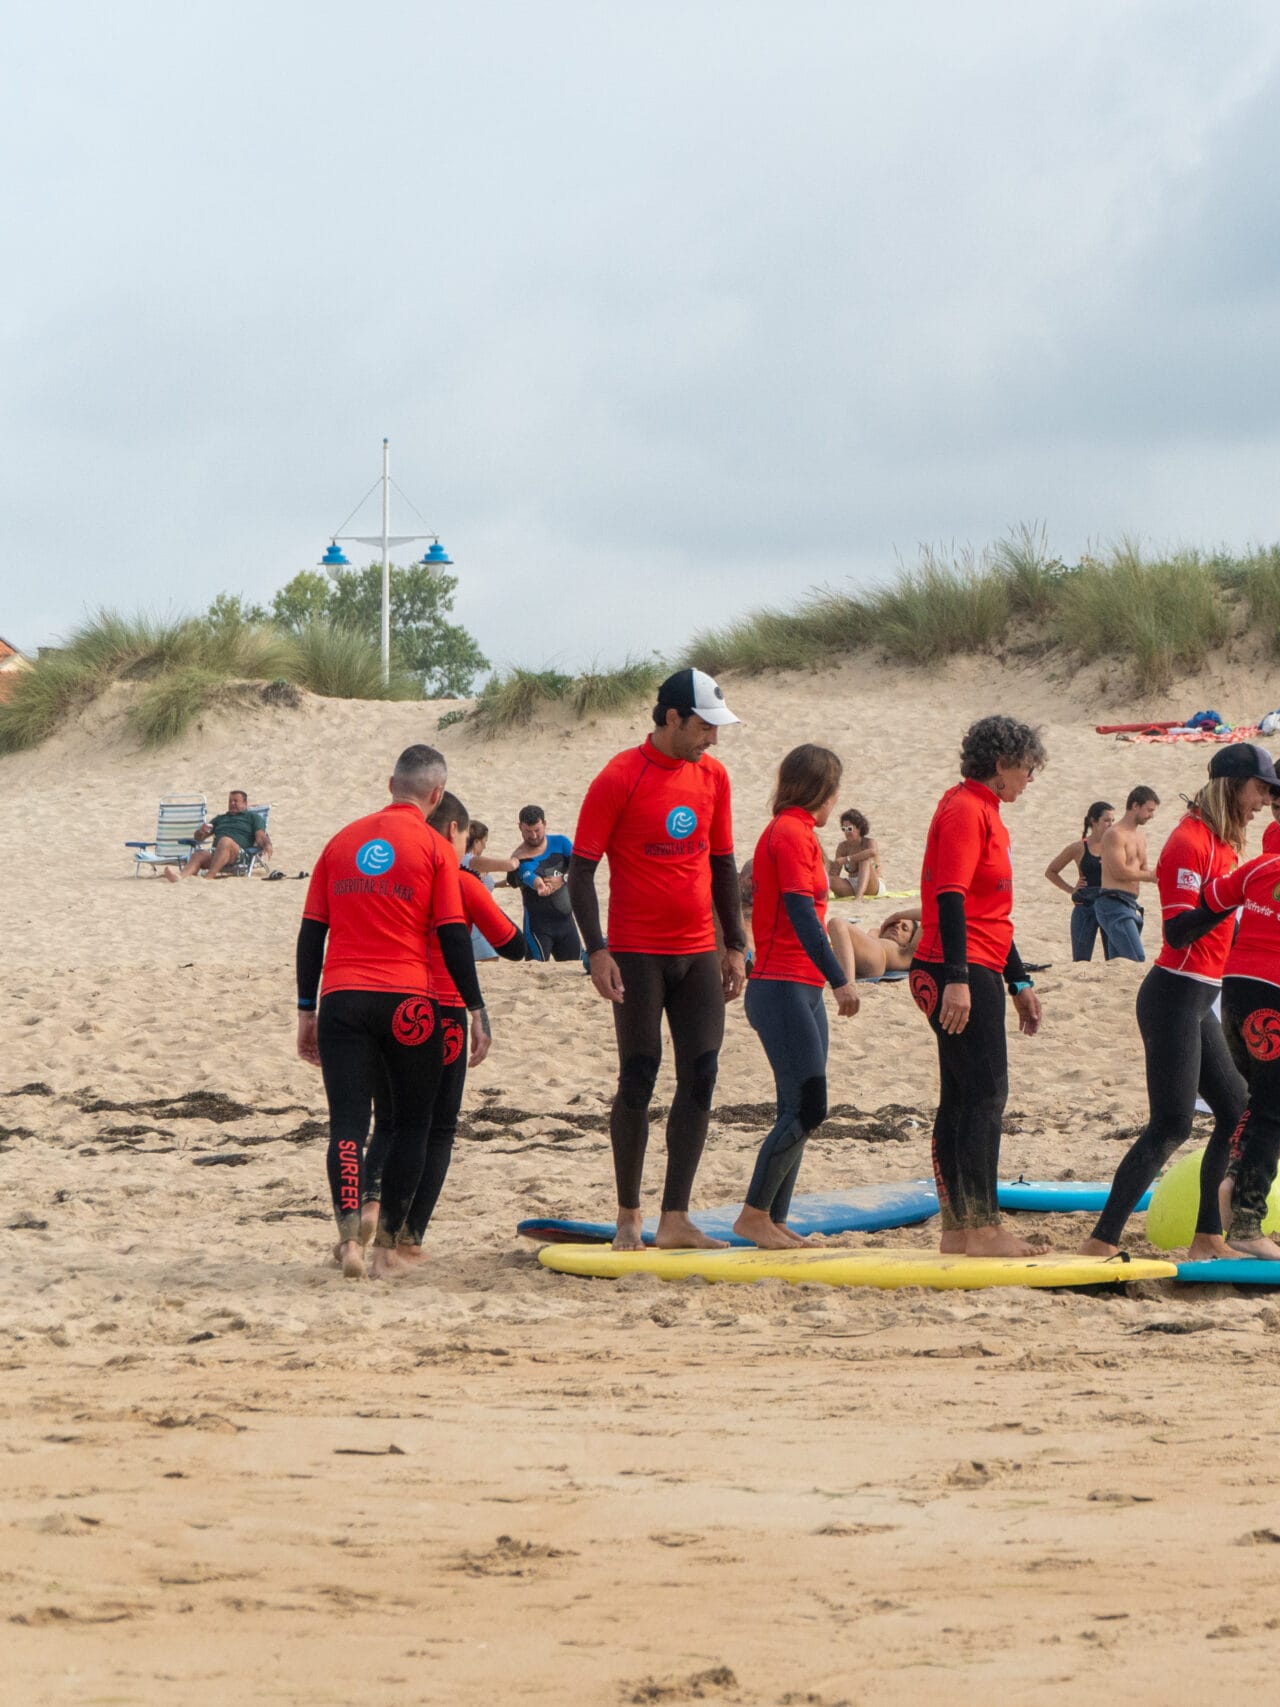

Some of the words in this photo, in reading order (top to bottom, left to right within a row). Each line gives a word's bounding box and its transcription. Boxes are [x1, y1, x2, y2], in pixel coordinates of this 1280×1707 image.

[334, 879, 376, 896] DISFRUTAR
[378, 880, 389, 896] EL
[392, 883, 414, 902] MAR
[338, 1139, 359, 1210] SURFER
